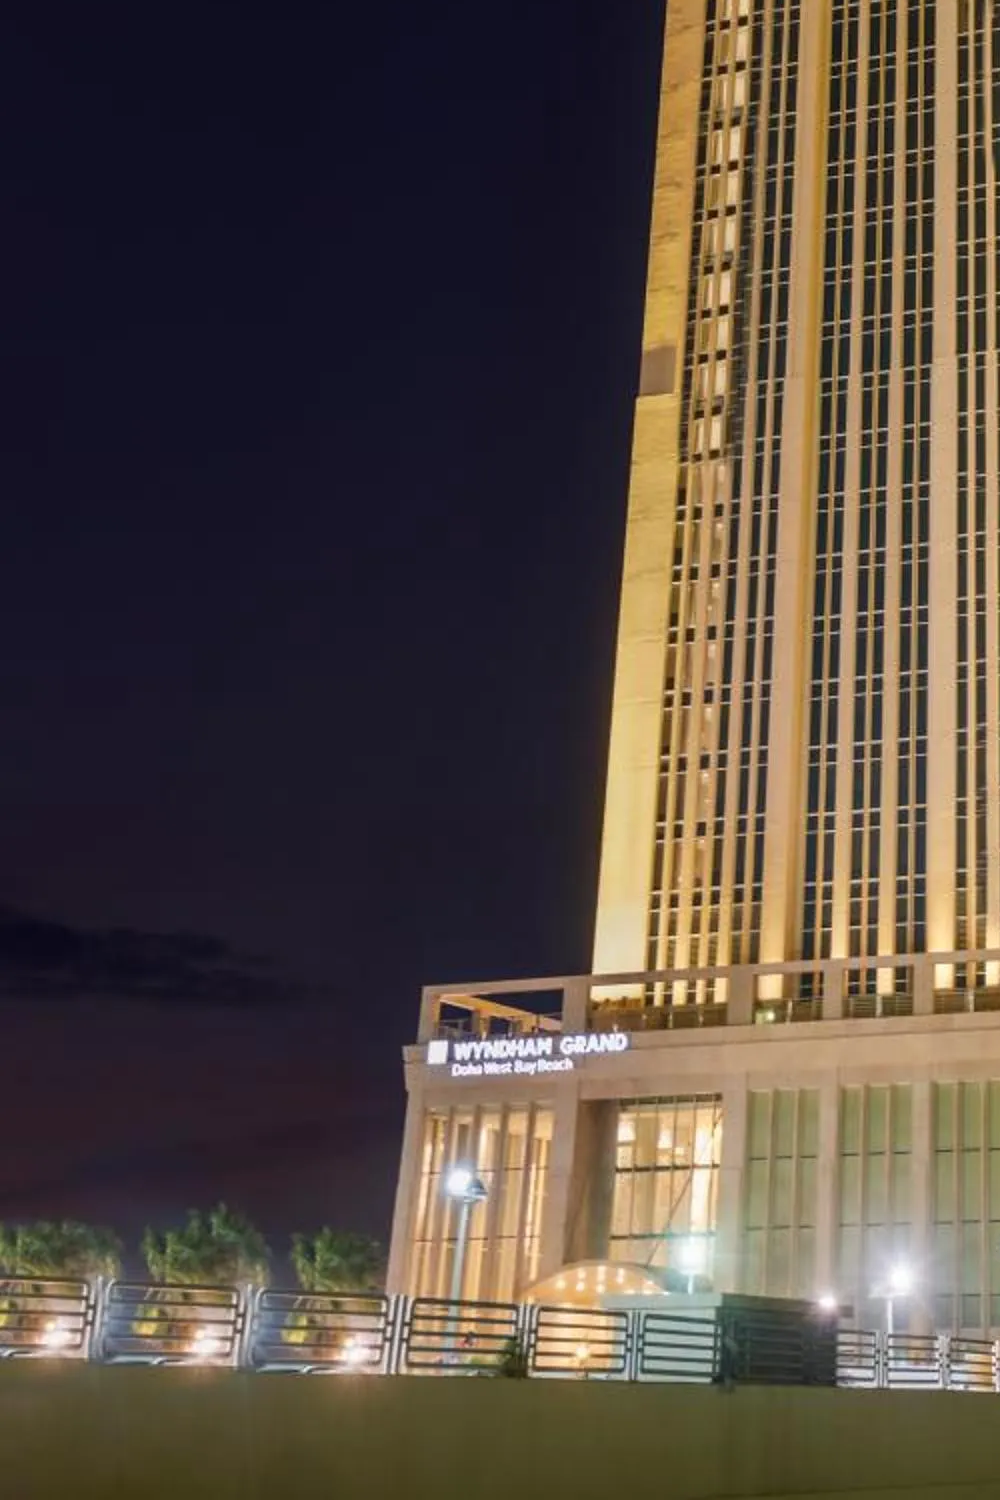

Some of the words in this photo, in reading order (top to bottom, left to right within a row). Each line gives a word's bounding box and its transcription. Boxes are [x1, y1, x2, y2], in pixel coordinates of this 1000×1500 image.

[454, 1037, 553, 1061] WYNDHAM
[560, 1033, 628, 1055] GRAND
[451, 1062, 482, 1077] Doha
[484, 1061, 512, 1074] West
[514, 1059, 536, 1076] Bay
[538, 1058, 573, 1072] Beach
